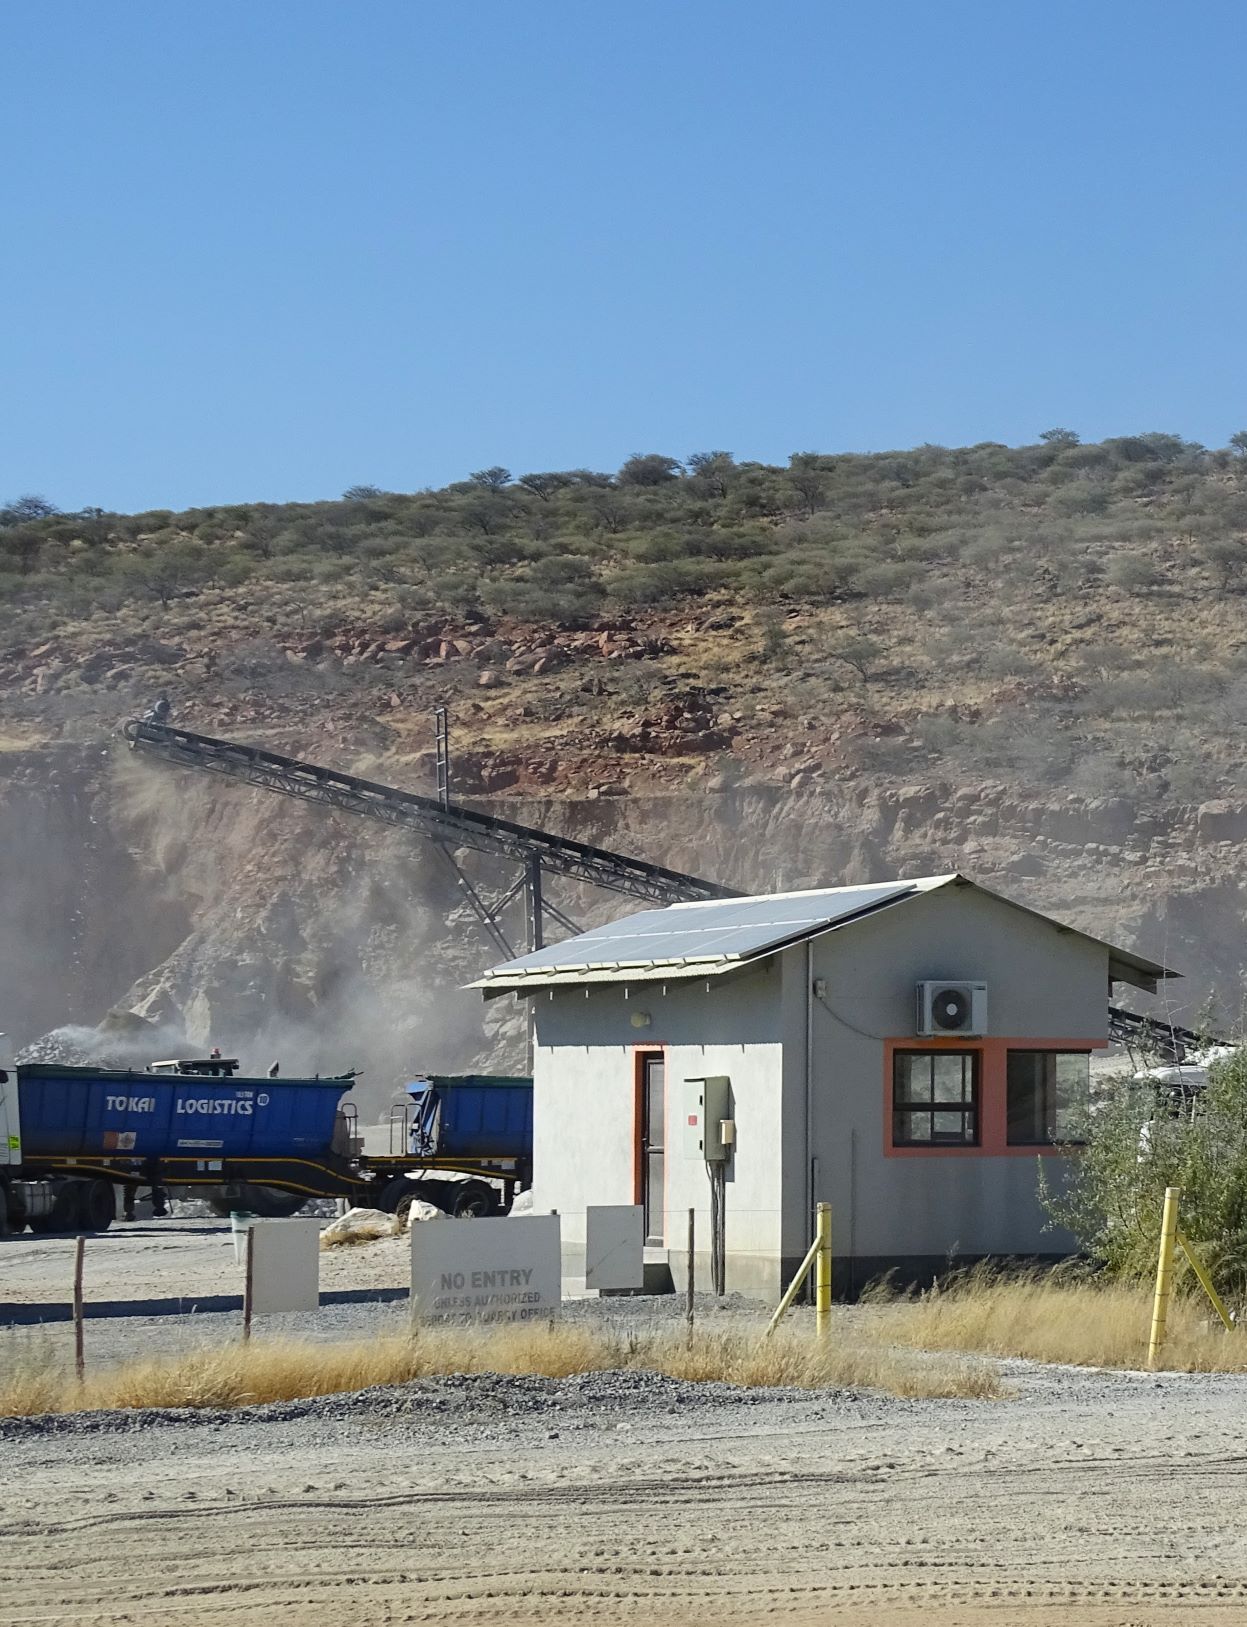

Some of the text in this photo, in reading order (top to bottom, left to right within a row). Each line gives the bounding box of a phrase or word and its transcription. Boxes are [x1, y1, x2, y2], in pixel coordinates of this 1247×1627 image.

[106, 1096, 253, 1115] TOKAI LOGISTICS
[441, 1268, 534, 1290] NO ENTRY
